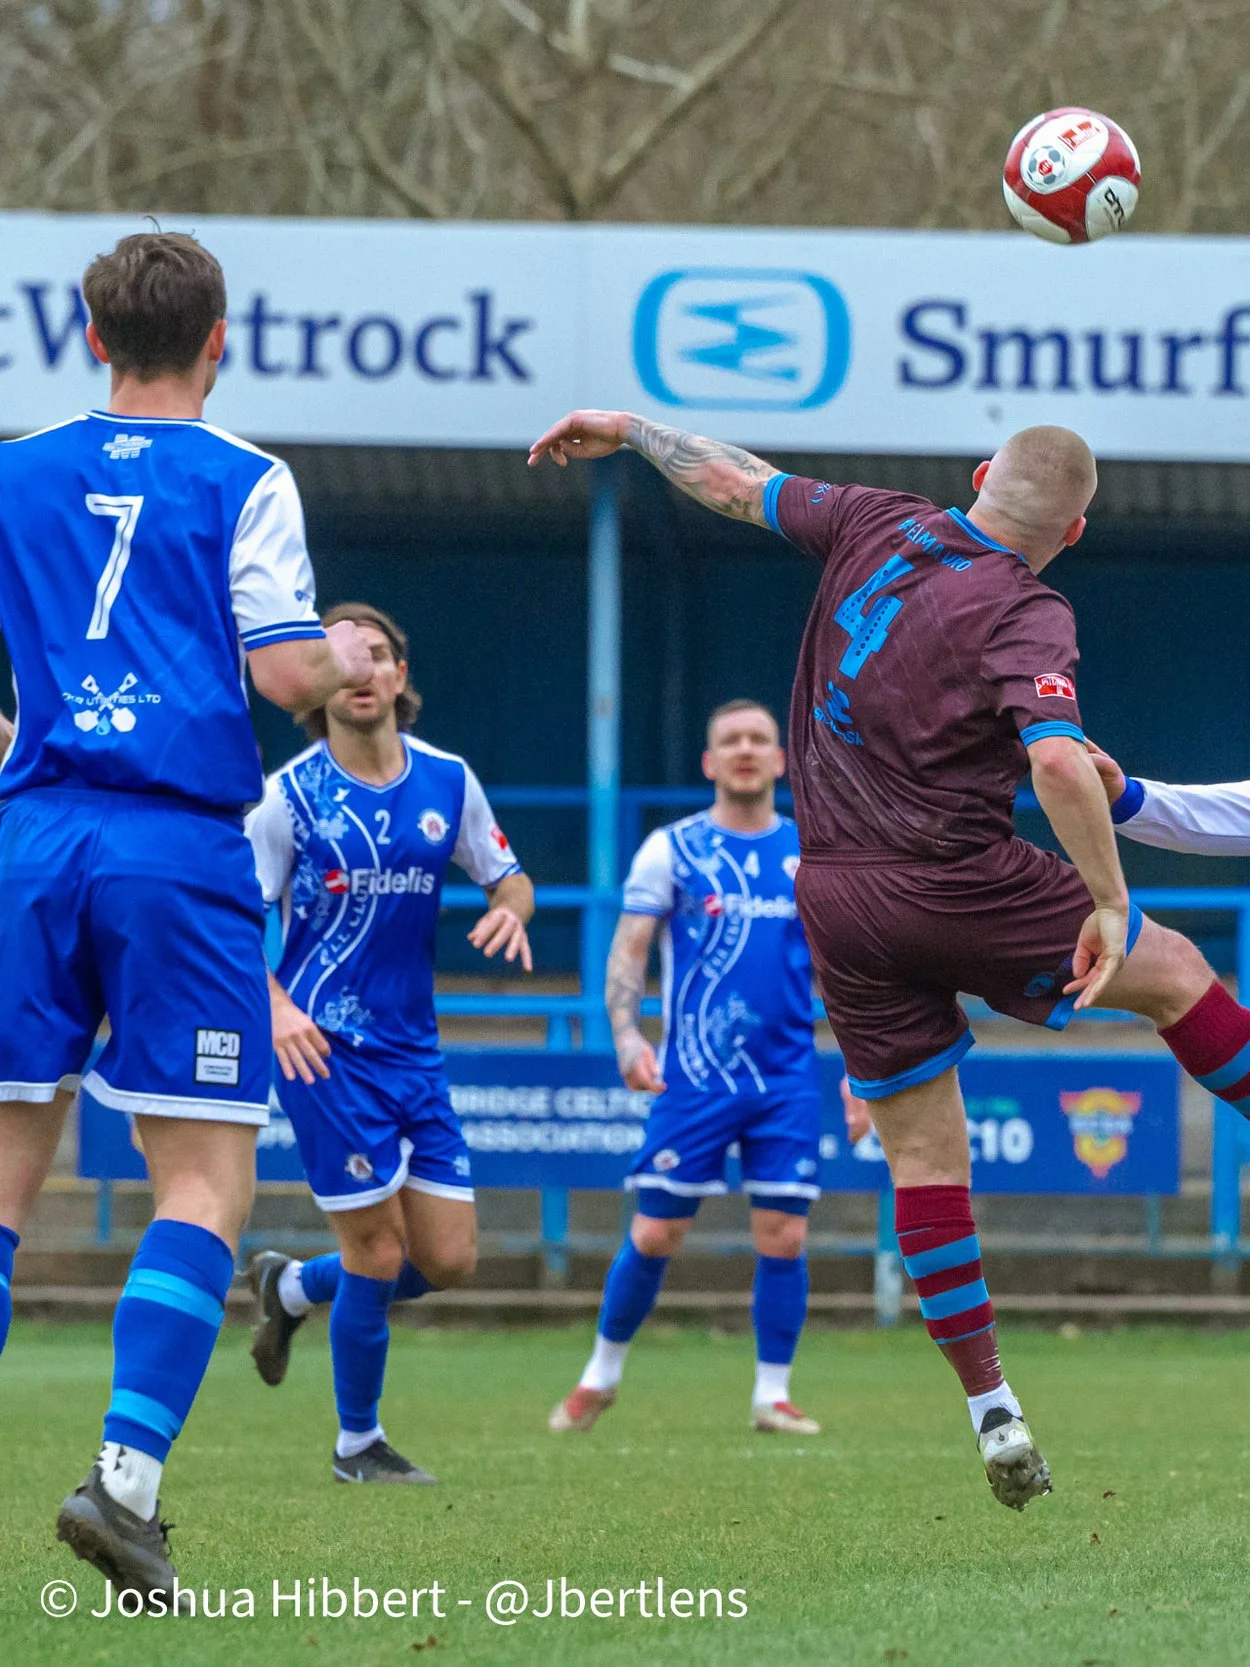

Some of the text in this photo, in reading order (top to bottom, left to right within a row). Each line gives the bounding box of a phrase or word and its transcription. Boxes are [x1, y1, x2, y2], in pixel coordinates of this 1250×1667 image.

[0, 281, 535, 384] Wtrock
[85, 493, 144, 640] 7
[833, 553, 916, 680] 4
[374, 809, 392, 845] 2
[350, 867, 435, 894] Fidelis
[743, 850, 760, 878] 4
[197, 1030, 240, 1057] MCD
